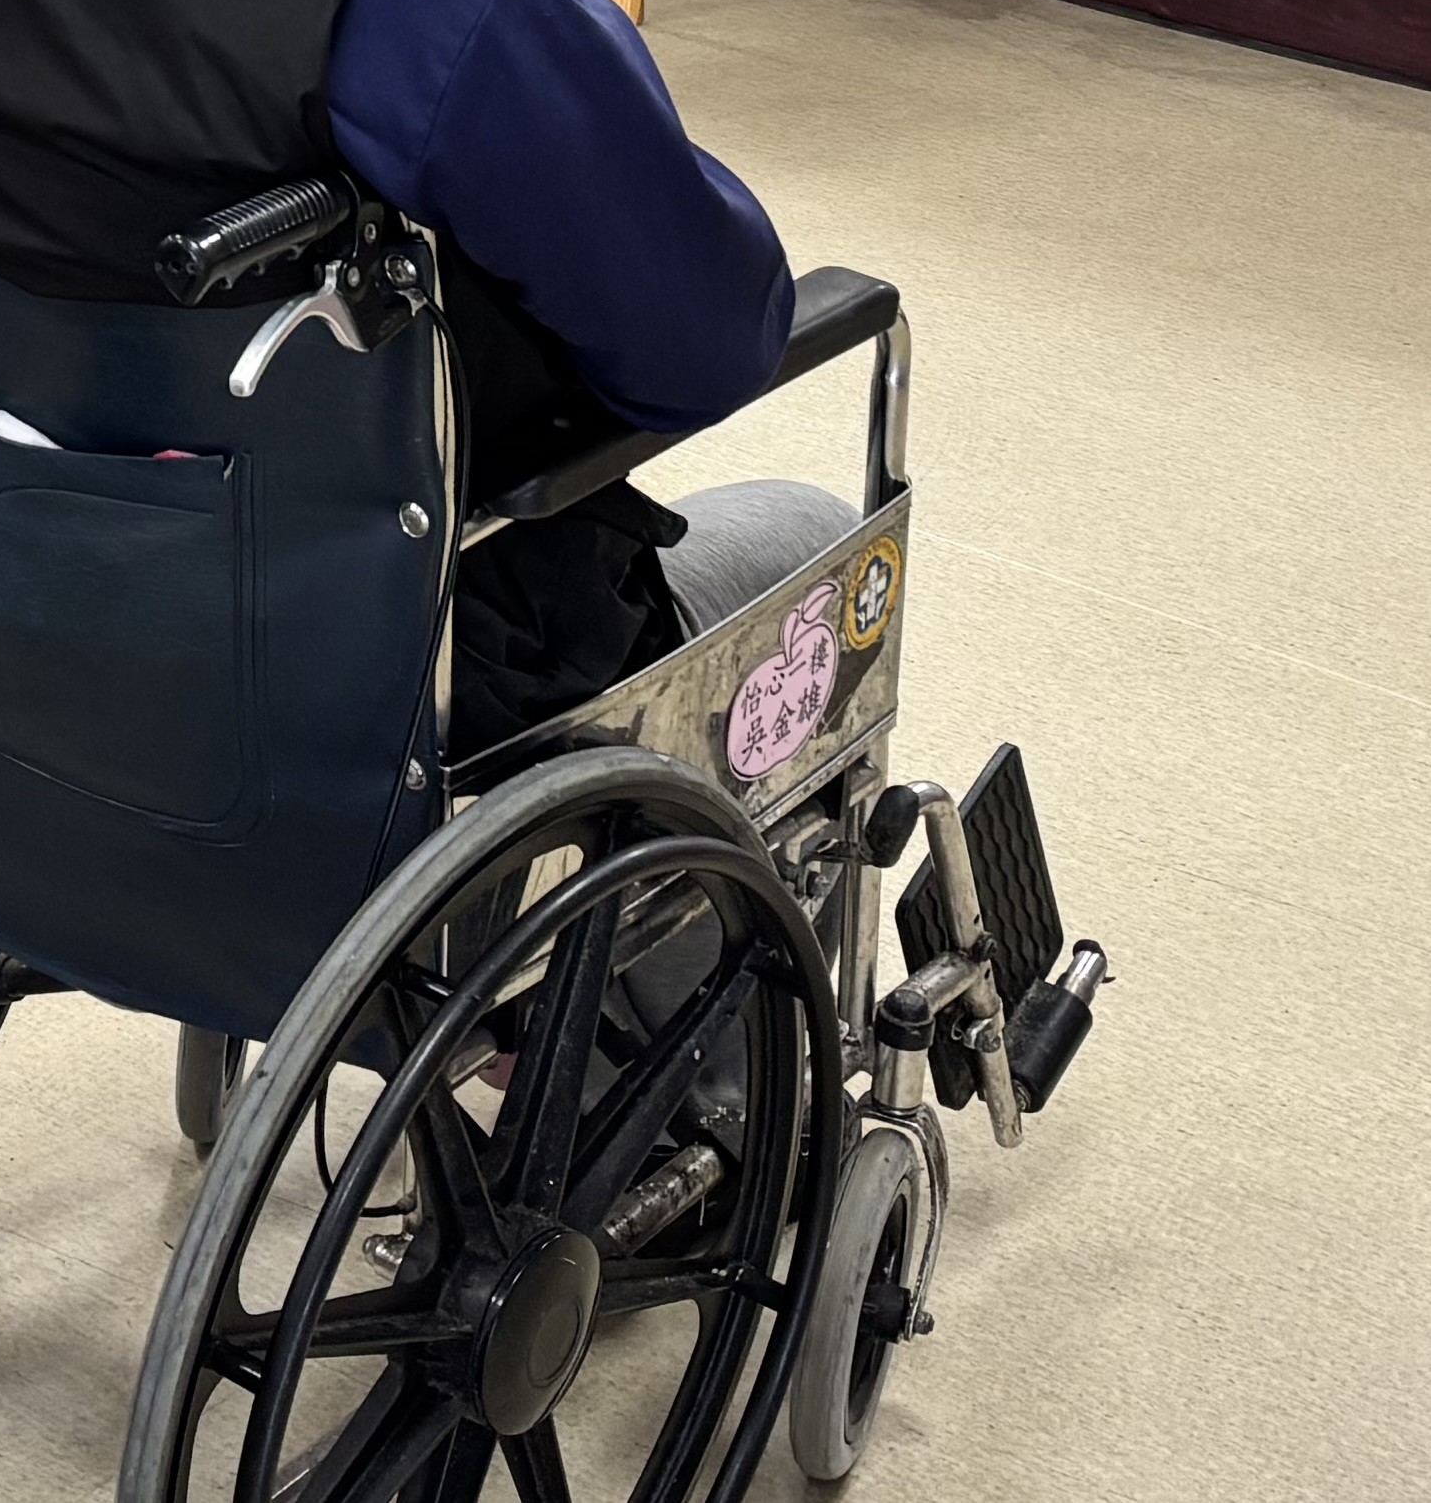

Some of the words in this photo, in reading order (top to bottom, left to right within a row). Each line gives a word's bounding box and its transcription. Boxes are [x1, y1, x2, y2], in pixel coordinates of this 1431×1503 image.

[740, 634, 830, 720] 怡心一樓
[741, 679, 823, 768] 吳金雄
